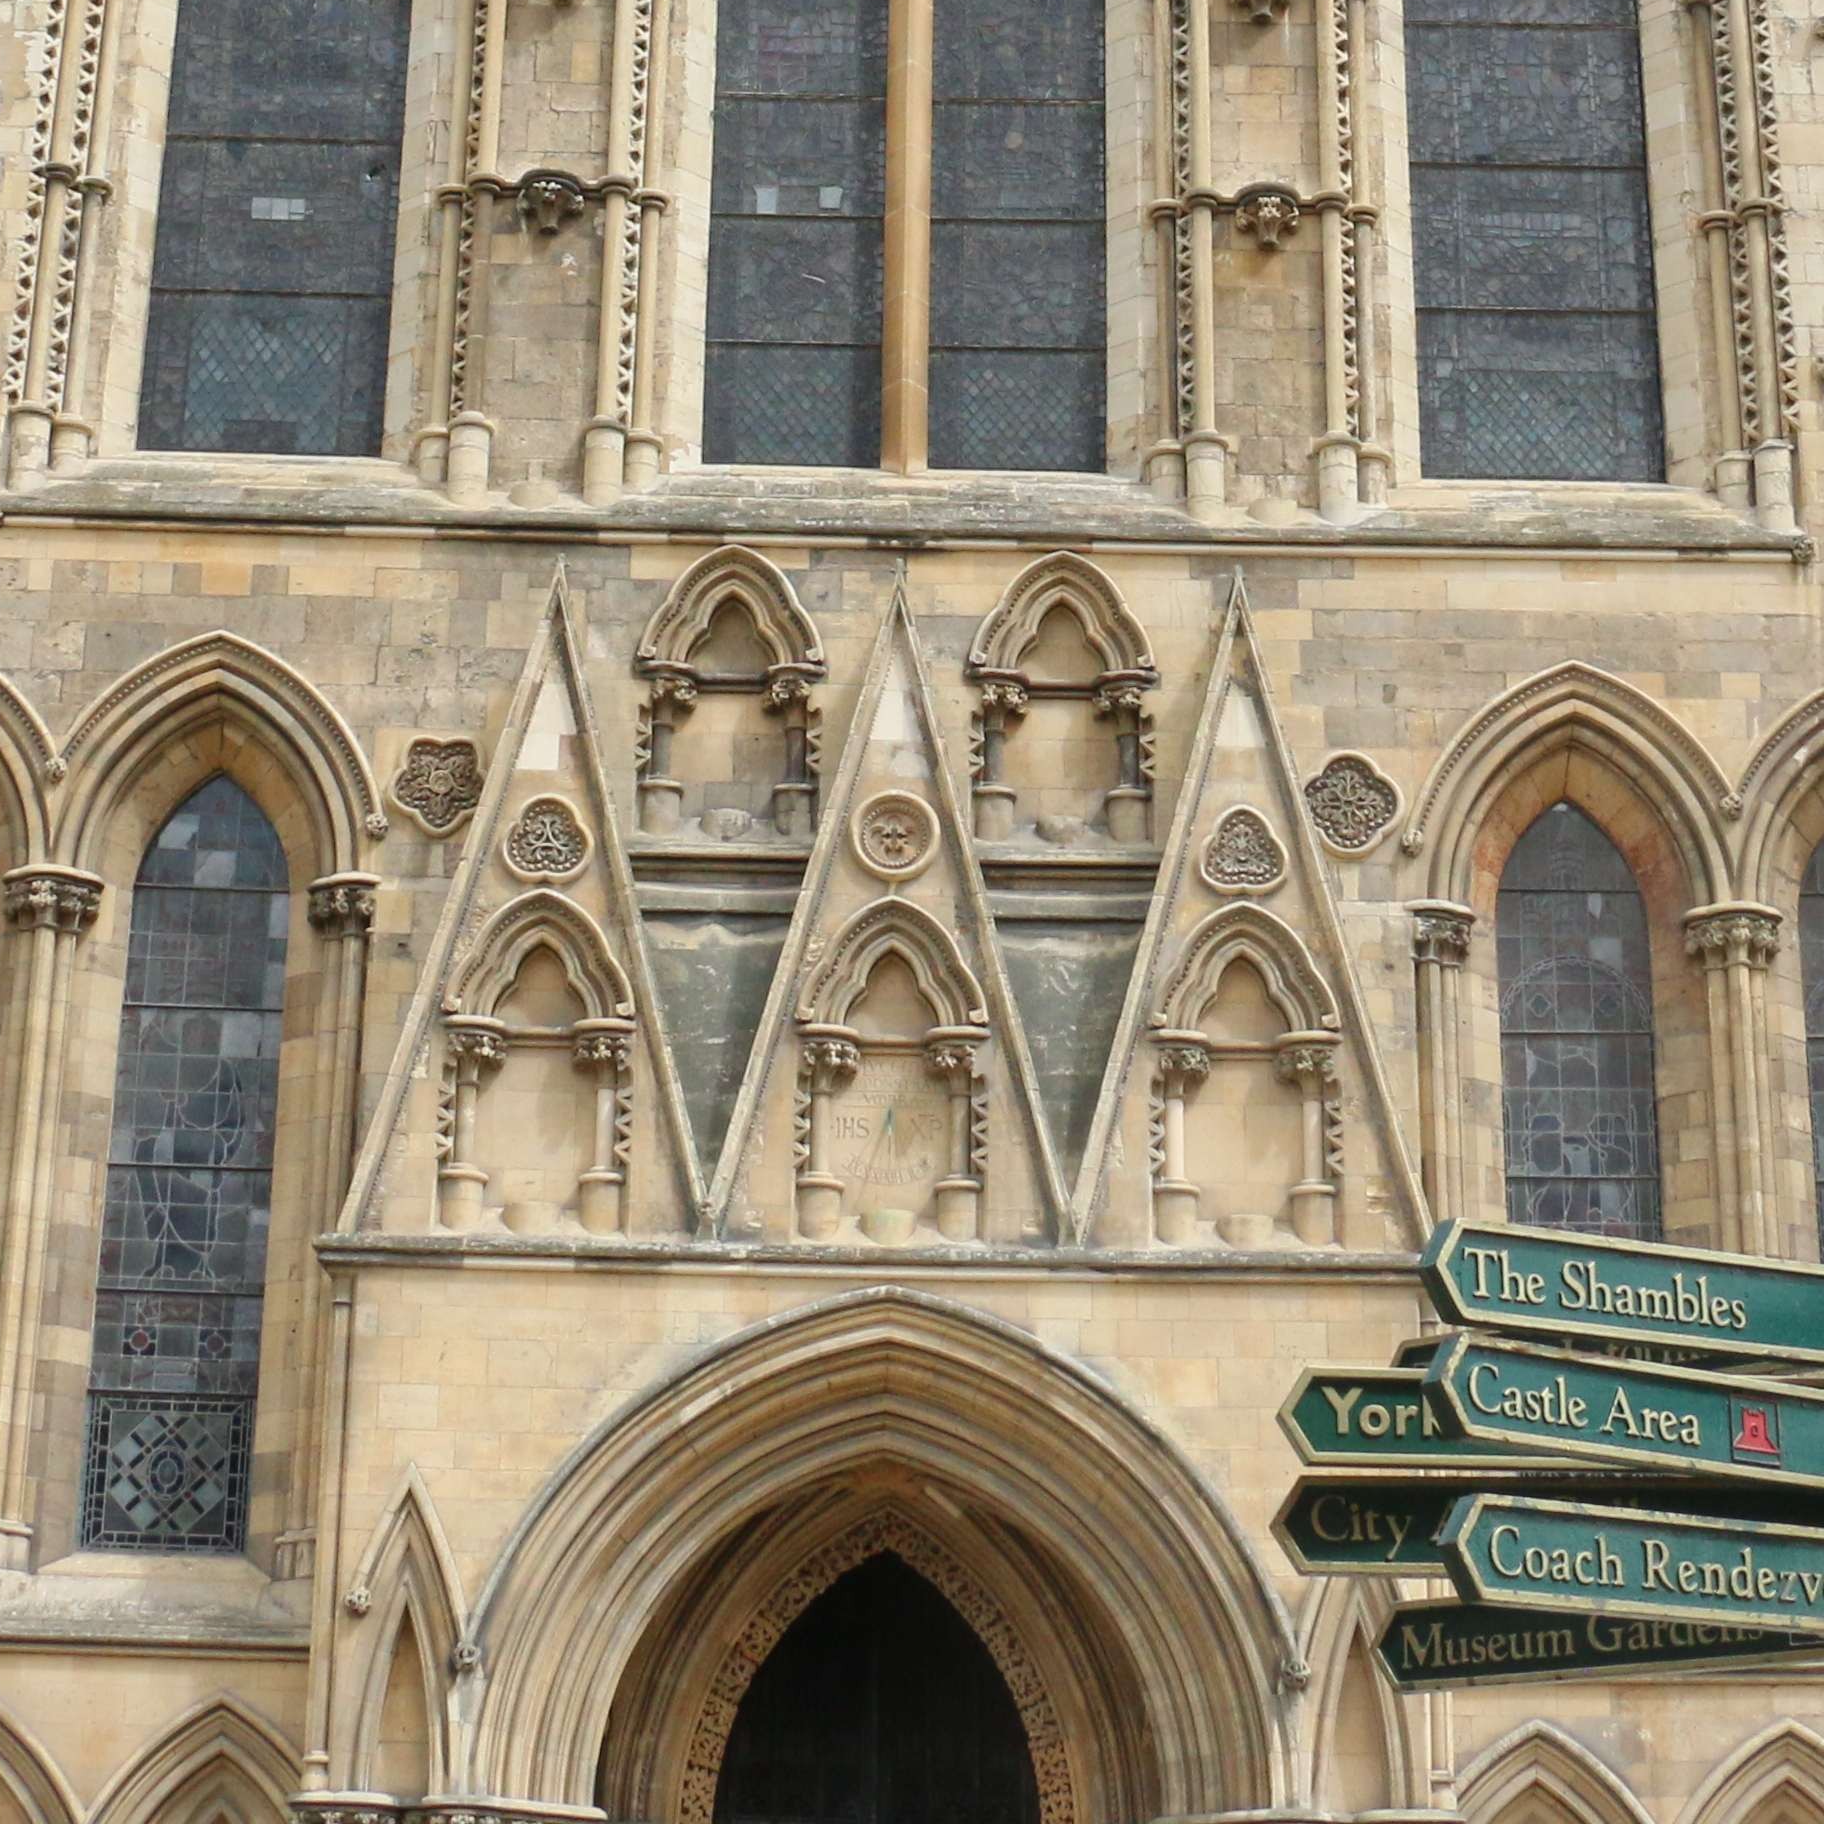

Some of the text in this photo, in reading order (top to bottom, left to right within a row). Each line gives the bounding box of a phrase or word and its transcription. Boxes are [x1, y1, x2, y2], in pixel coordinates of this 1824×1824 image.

[1464, 1246, 1748, 1330] The Shambles
[1467, 1362, 1702, 1447] Castle Area
[1310, 1494, 1412, 1561] City
[1488, 1524, 1625, 1588] Coach
[1401, 1622, 1575, 1671] Museum
